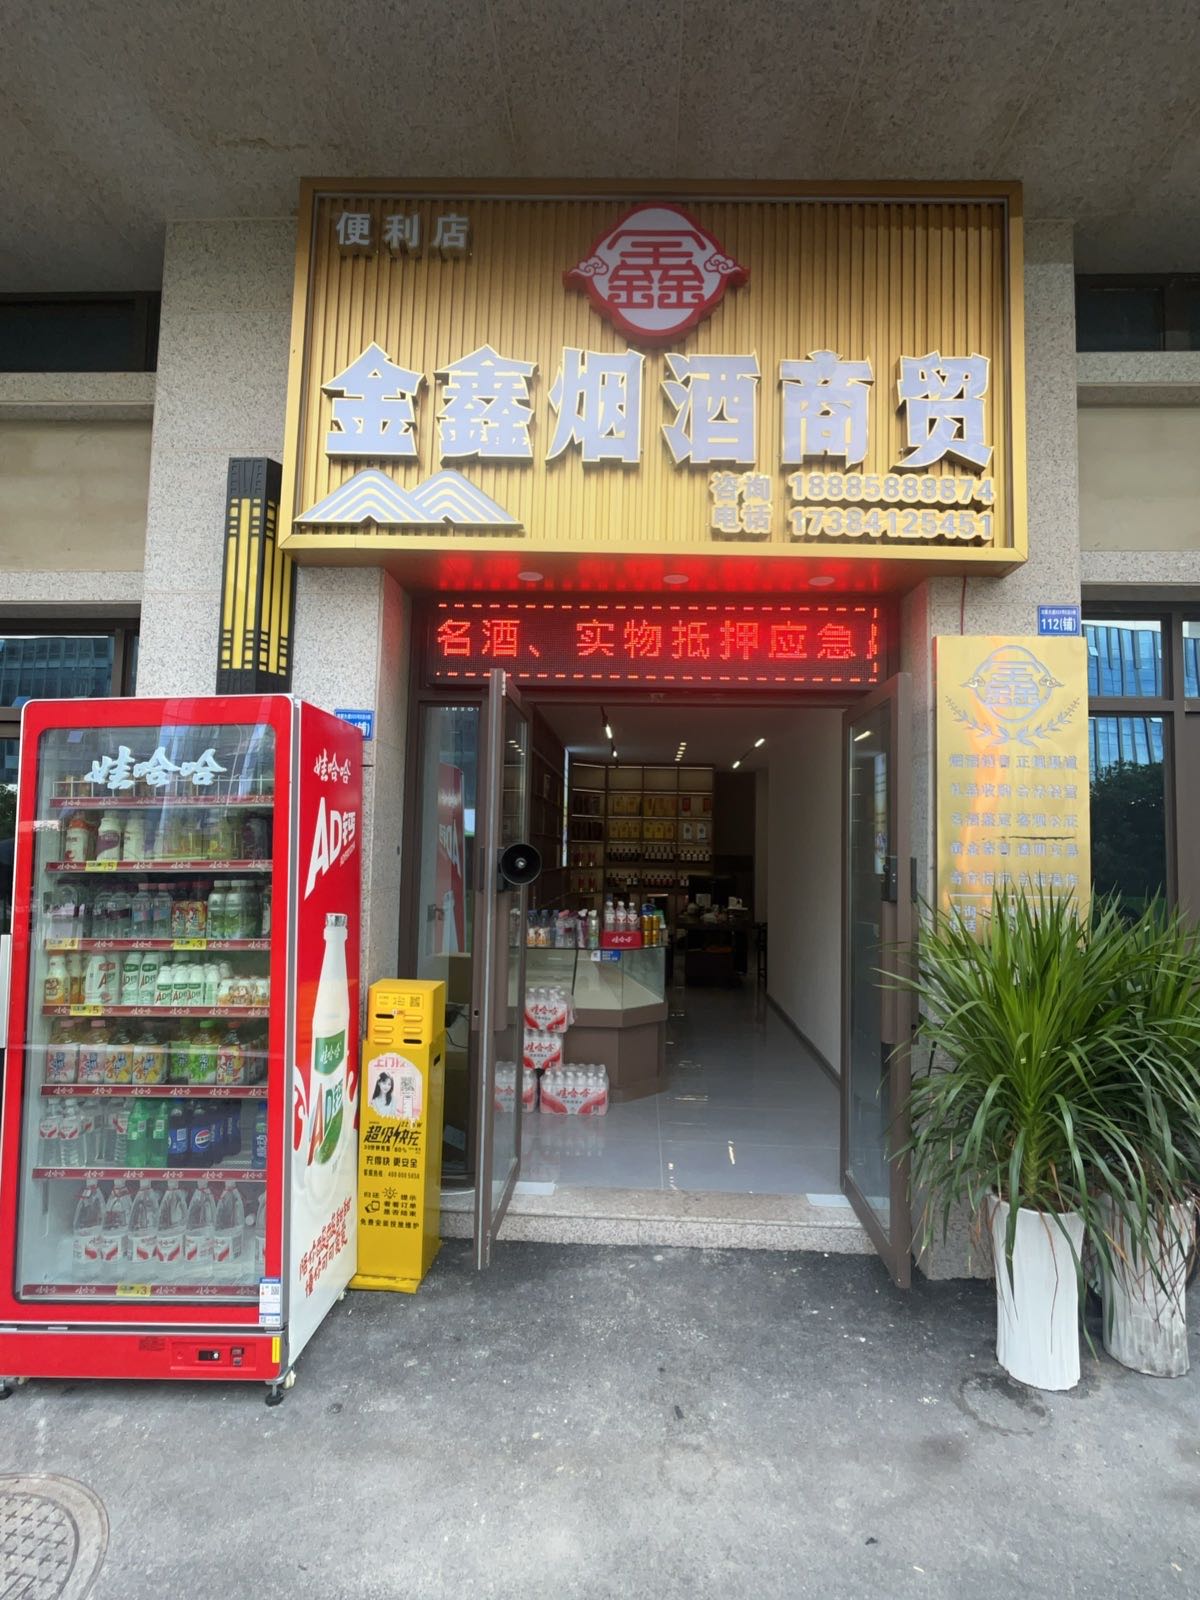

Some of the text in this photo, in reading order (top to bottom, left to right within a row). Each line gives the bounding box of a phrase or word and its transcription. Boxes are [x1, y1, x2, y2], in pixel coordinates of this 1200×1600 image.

[336, 212, 468, 248] 便利店
[320, 341, 992, 471] 金鑫烟酒商贸
[711, 472, 995, 505] 咨询 18885888874
[711, 503, 994, 540] 电话 17384125451
[437, 619, 877, 659] 名酒、实物抵押应急
[1041, 616, 1076, 631] 112(铺)
[84, 745, 227, 790] 娃哈哈
[314, 748, 351, 784] 娃哈哈
[364, 1124, 422, 1147] 超级快充
[366, 1156, 418, 1168] 充得快 更安全
